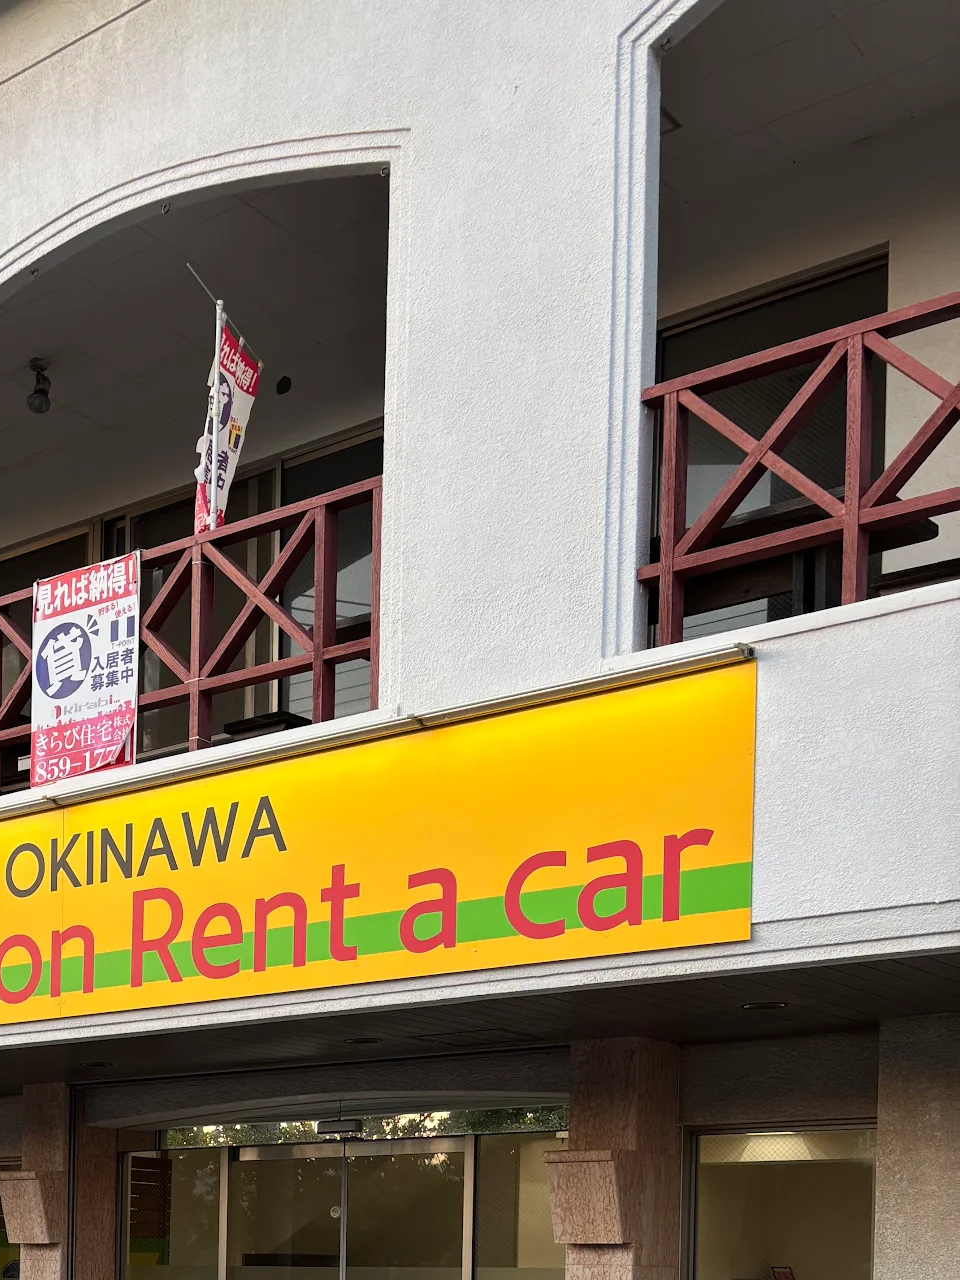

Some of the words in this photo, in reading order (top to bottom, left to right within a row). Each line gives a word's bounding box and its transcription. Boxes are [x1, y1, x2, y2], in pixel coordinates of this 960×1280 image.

[38, 561, 135, 616] 見れば納得!
[91, 647, 135, 672] 入居者
[91, 667, 135, 692] 募集中
[35, 720, 113, 756] きらび住宅
[6, 795, 288, 898] OKINAWA
[130, 863, 361, 988] Rent
[399, 867, 457, 953] a
[505, 828, 715, 940] car
